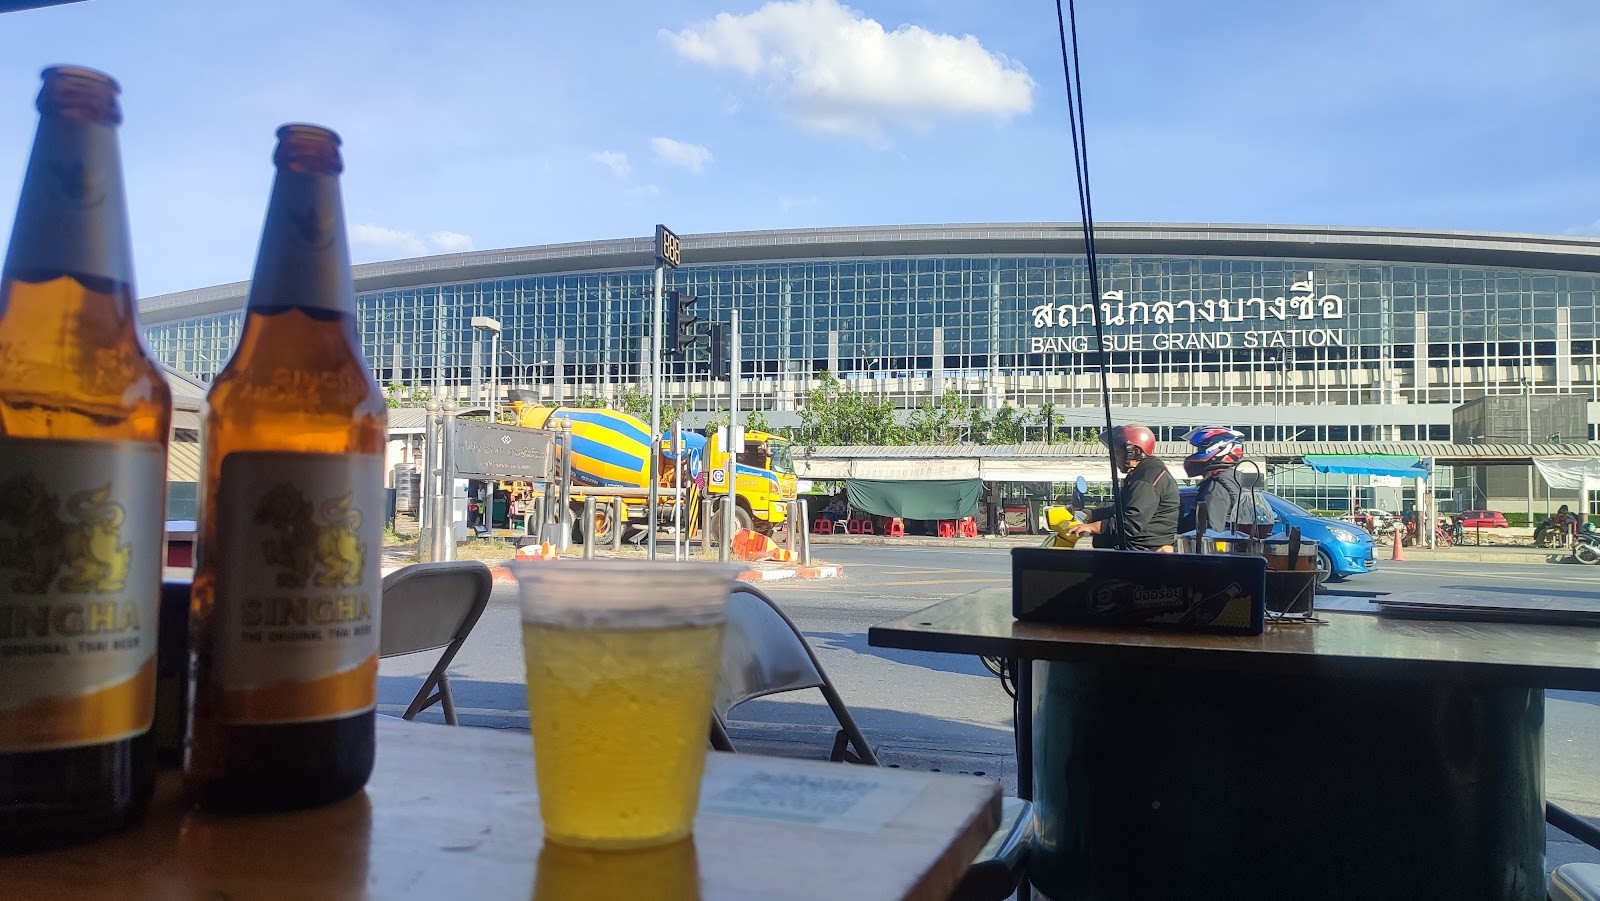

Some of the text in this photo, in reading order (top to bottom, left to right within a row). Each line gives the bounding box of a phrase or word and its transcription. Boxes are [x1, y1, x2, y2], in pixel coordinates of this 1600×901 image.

[1031, 271, 1343, 329] สถานีกลางบางซื่อ
[1031, 328, 1343, 353] BANG SUE GRAND STATION
[240, 595, 372, 626] SINGHA
